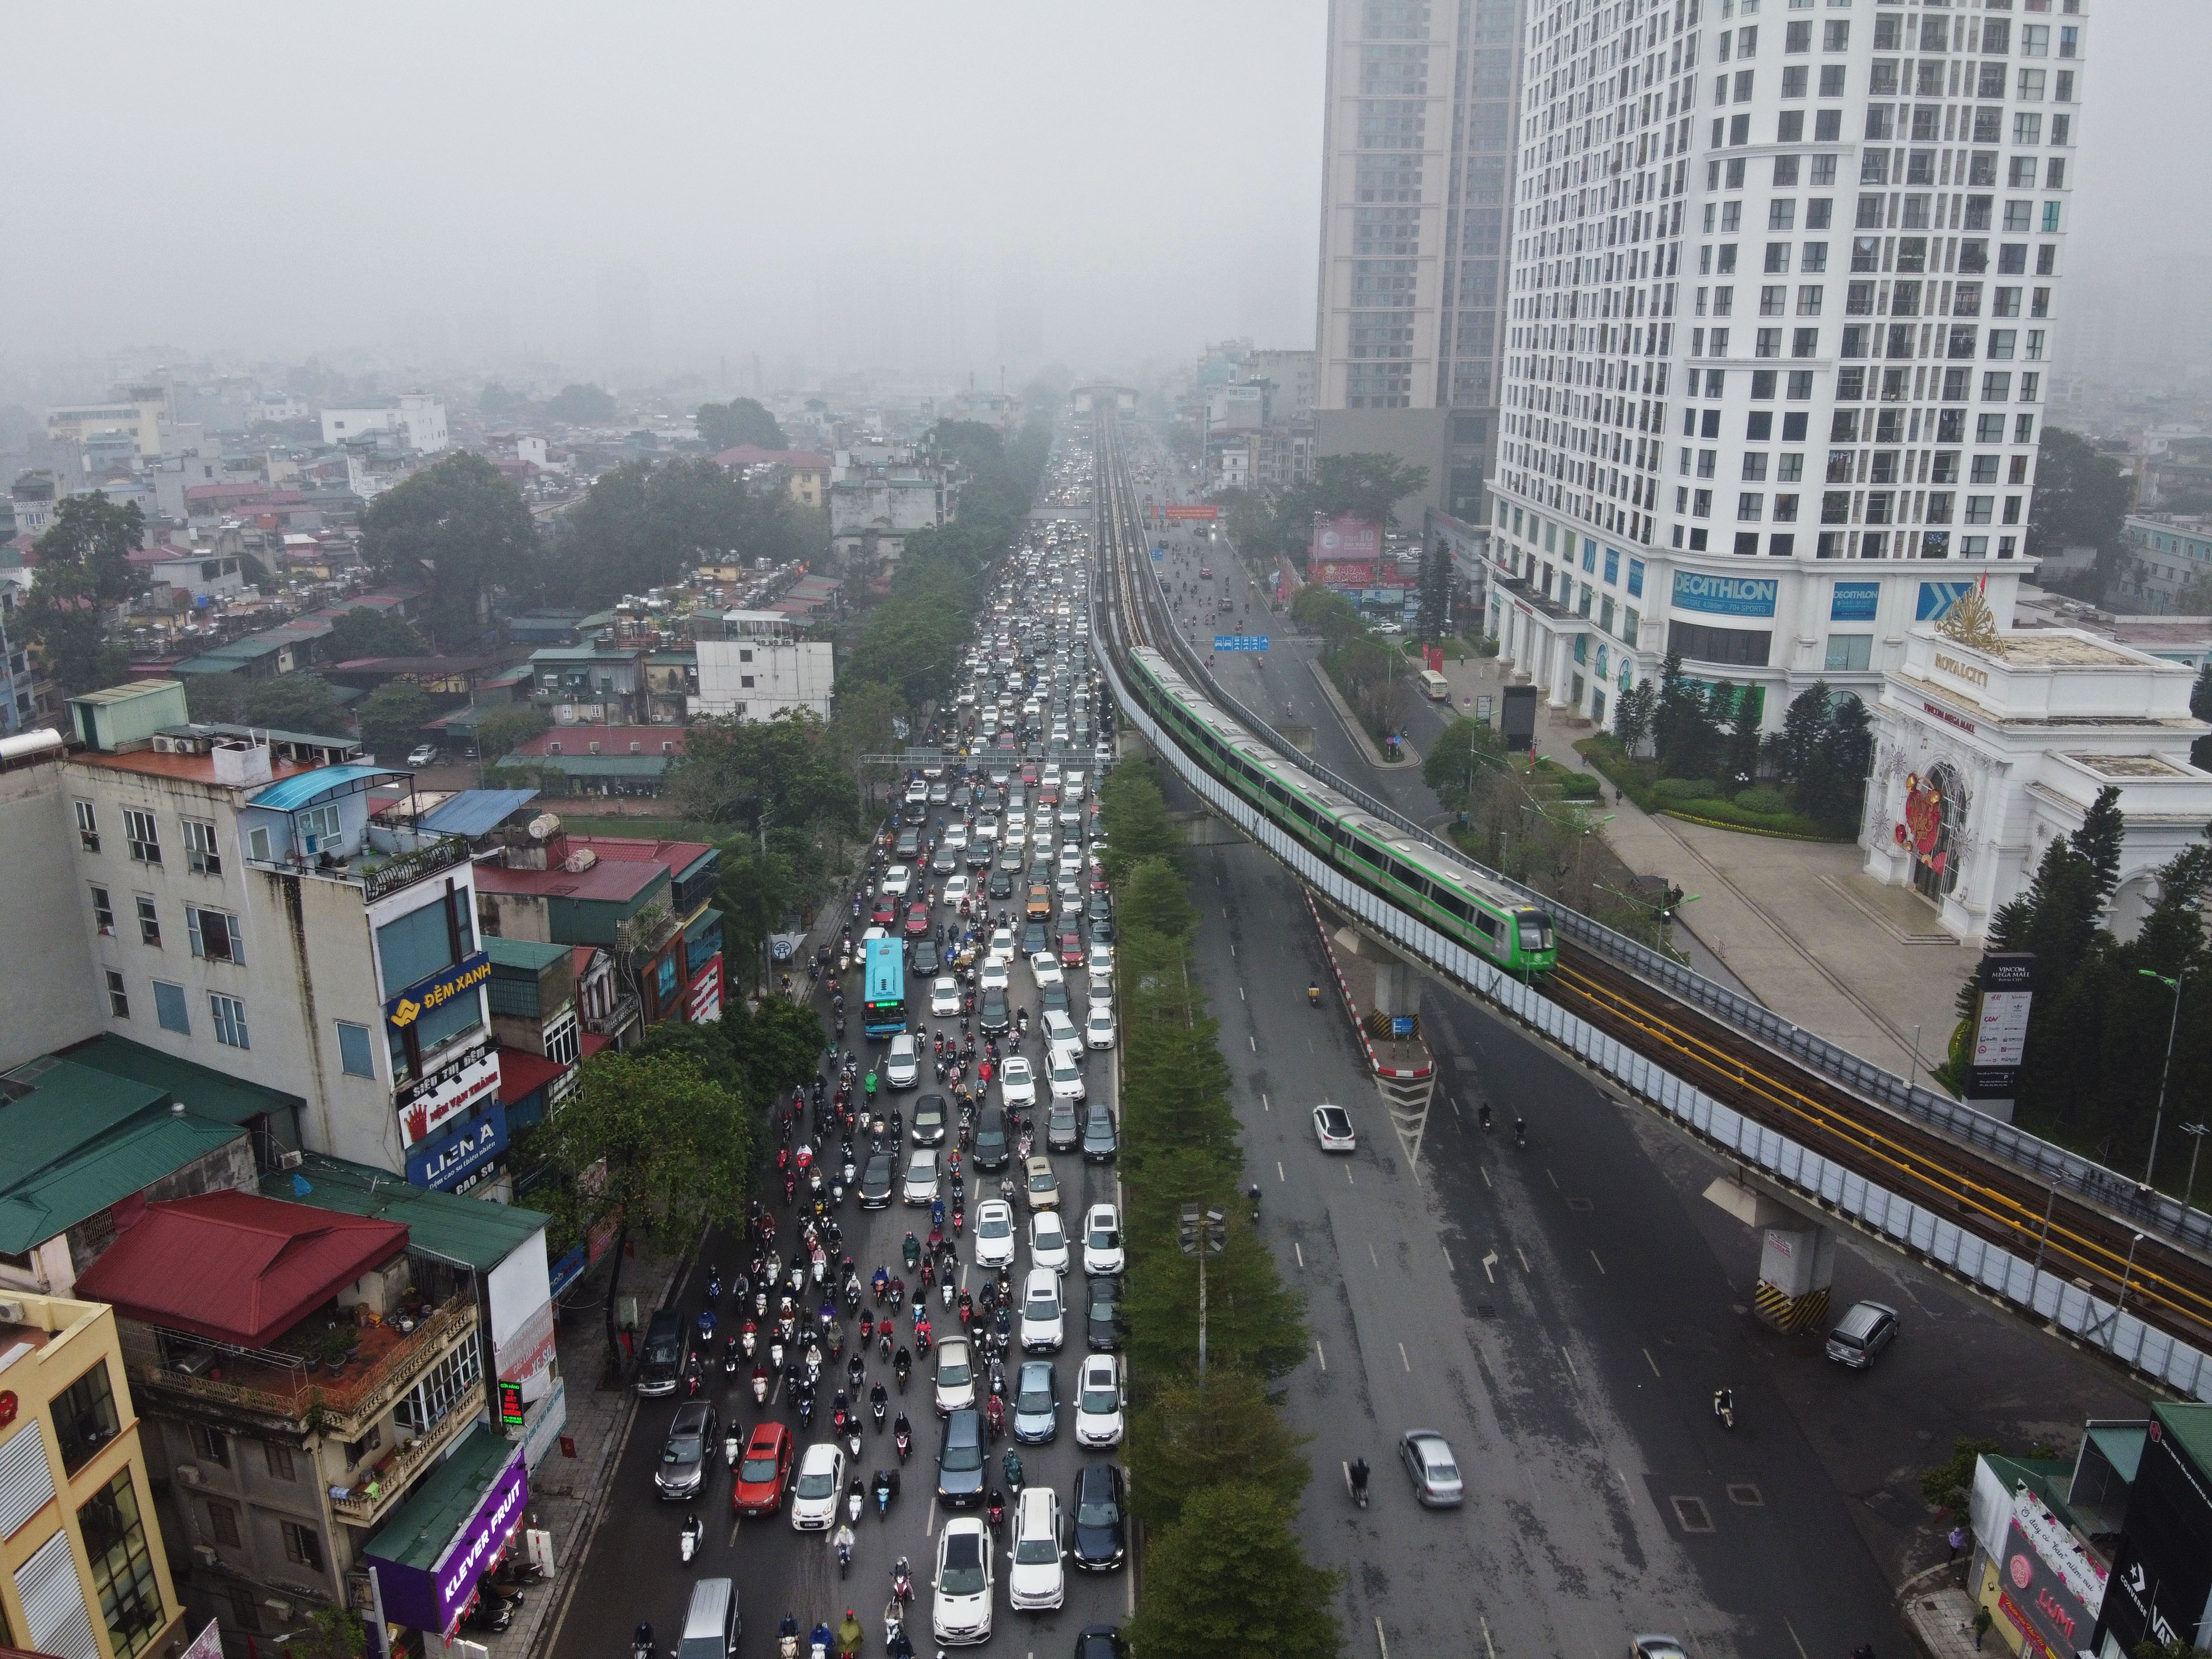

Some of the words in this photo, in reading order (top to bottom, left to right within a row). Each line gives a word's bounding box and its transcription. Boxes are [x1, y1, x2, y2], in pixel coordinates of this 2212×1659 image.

[1675, 573, 1775, 601] DECATHLON
[1834, 591, 1878, 599] DECATHLON
[1741, 604, 1766, 613] SPORTS
[1924, 702, 1944, 720] VINCOM
[1944, 712, 1960, 727] MEGA
[1960, 720, 1975, 734] MALL
[424, 984, 455, 1009] ĐỆM
[456, 962, 491, 992] XANH
[456, 1175, 477, 1196] CAO
[481, 1161, 494, 1177] SU
[445, 1529, 490, 1603] KLEVER
[491, 1479, 521, 1534] FRUIT
[2039, 1588, 2076, 1637] LUMI
[2120, 1574, 2148, 1618] CONVERSE
